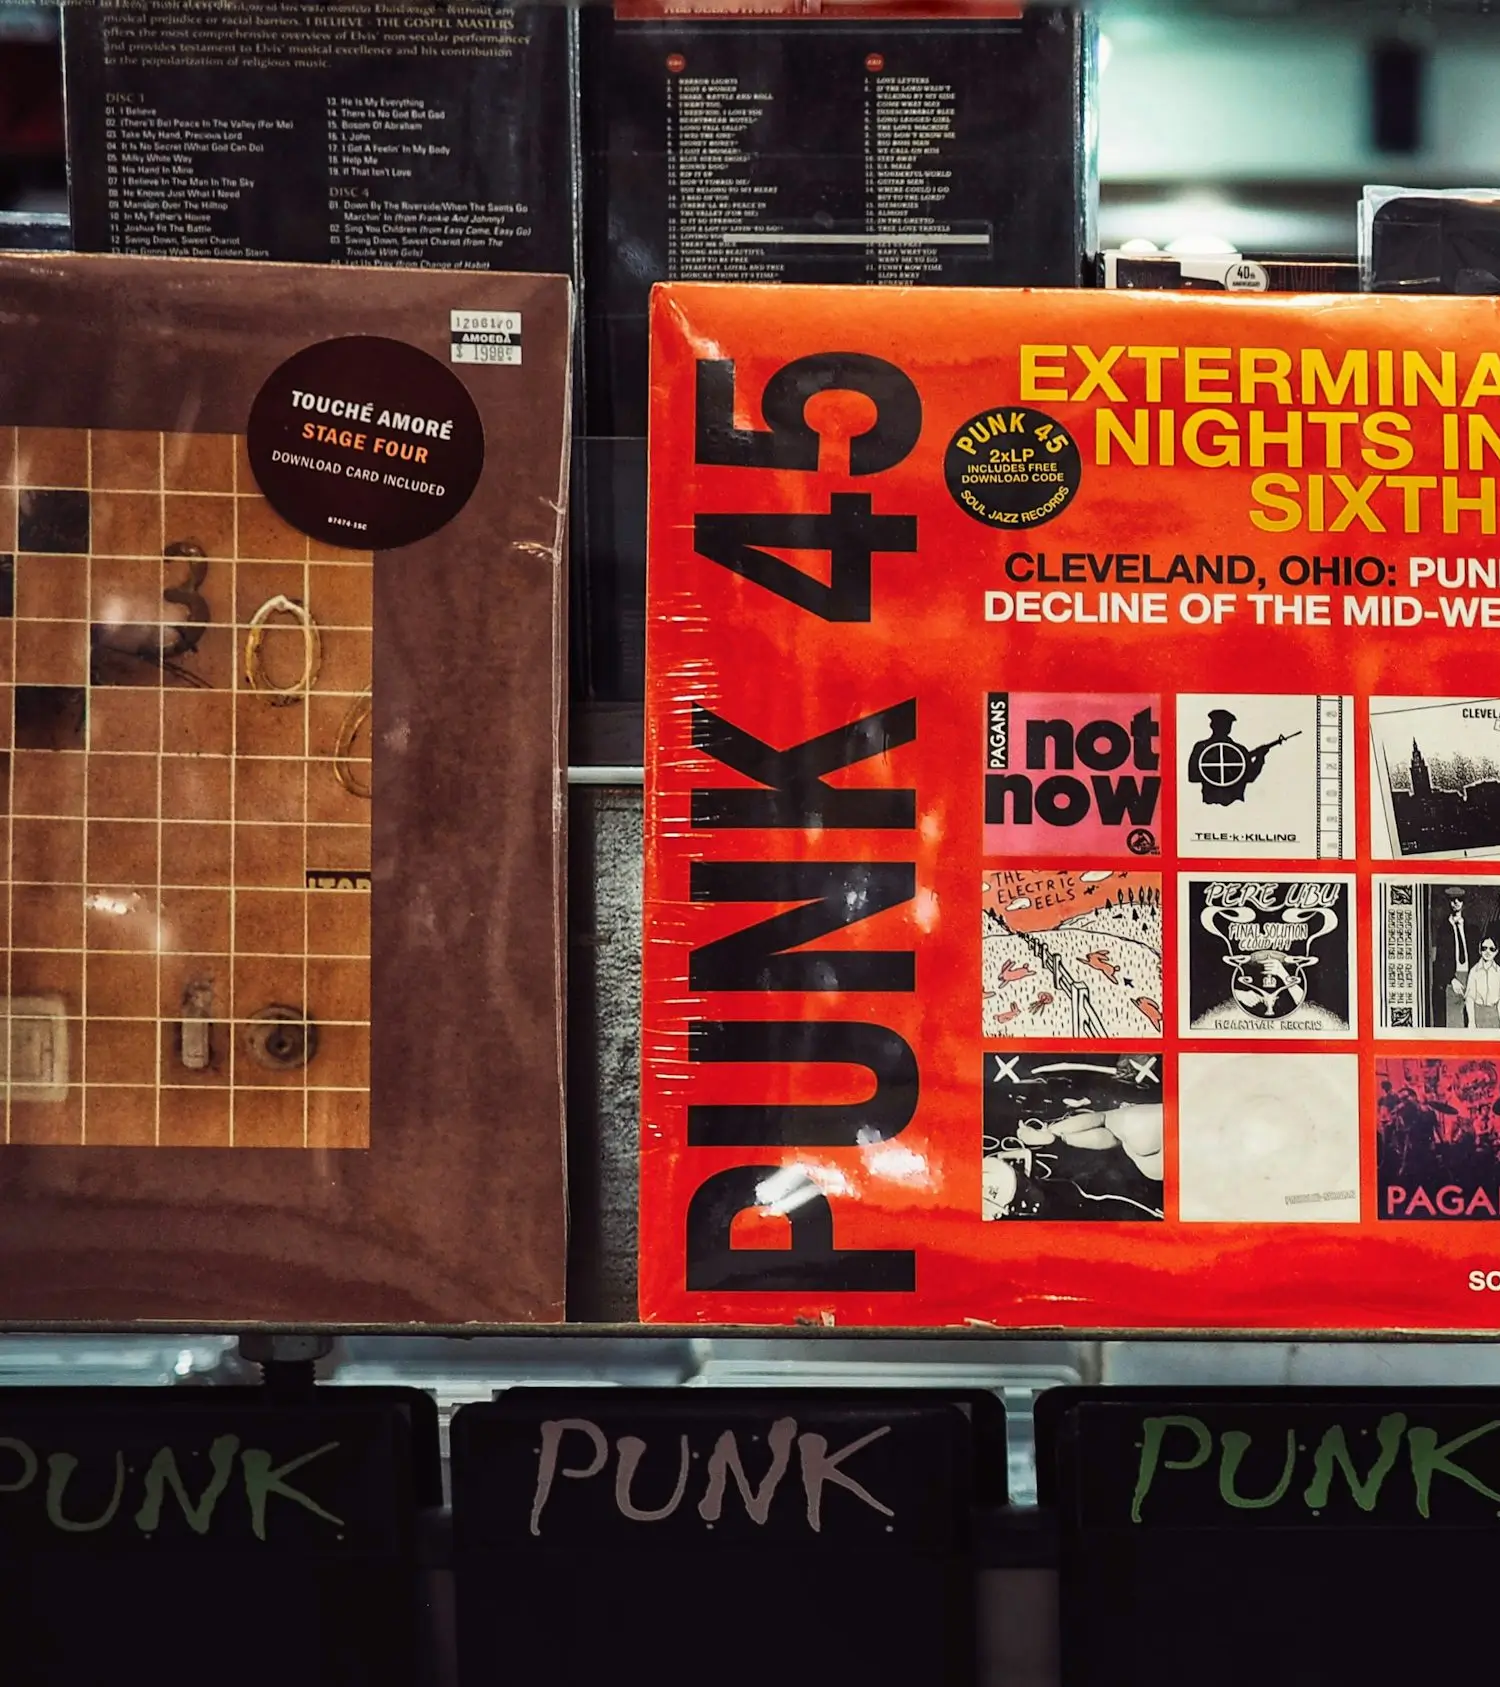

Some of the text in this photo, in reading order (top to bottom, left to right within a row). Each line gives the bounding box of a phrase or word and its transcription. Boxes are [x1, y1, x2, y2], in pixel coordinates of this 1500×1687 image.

[462, 333, 511, 343] AMOEBA
[292, 390, 453, 440] TOUCHÉ AMORÉ
[956, 412, 1069, 455] PUNK 45
[302, 422, 429, 464] STAGE FOUR
[989, 448, 1034, 463] 2xLP
[1095, 408, 1416, 472] NIGHTS
[272, 450, 445, 497] DOWNLOAD CARD INCLUDED
[694, 350, 924, 624] 45
[961, 473, 1064, 484] DOWNLOAD CODE
[968, 463, 1057, 473] INCLUDES FREE
[961, 486, 1069, 523] SOUL JAZZ RECORDS
[1248, 472, 1497, 536] SIXTH
[1004, 552, 1266, 591] CLEVELAND,
[1278, 555, 1397, 588] OHIO:
[984, 590, 1169, 624] DECLINE
[1179, 593, 1238, 625] OF
[1247, 594, 1332, 626] THE
[990, 700, 1006, 768] PAGANS
[1026, 706, 1159, 770] not
[985, 774, 1161, 826] now
[997, 877, 1075, 904] ELECTRIC
[1035, 888, 1076, 910] EELS
[1204, 882, 1340, 912] PERE UBU
[1228, 923, 1309, 941] FINAL SOLUTION
[685, 697, 921, 1294] PUNK
[531, 1416, 894, 1536] PUNK
